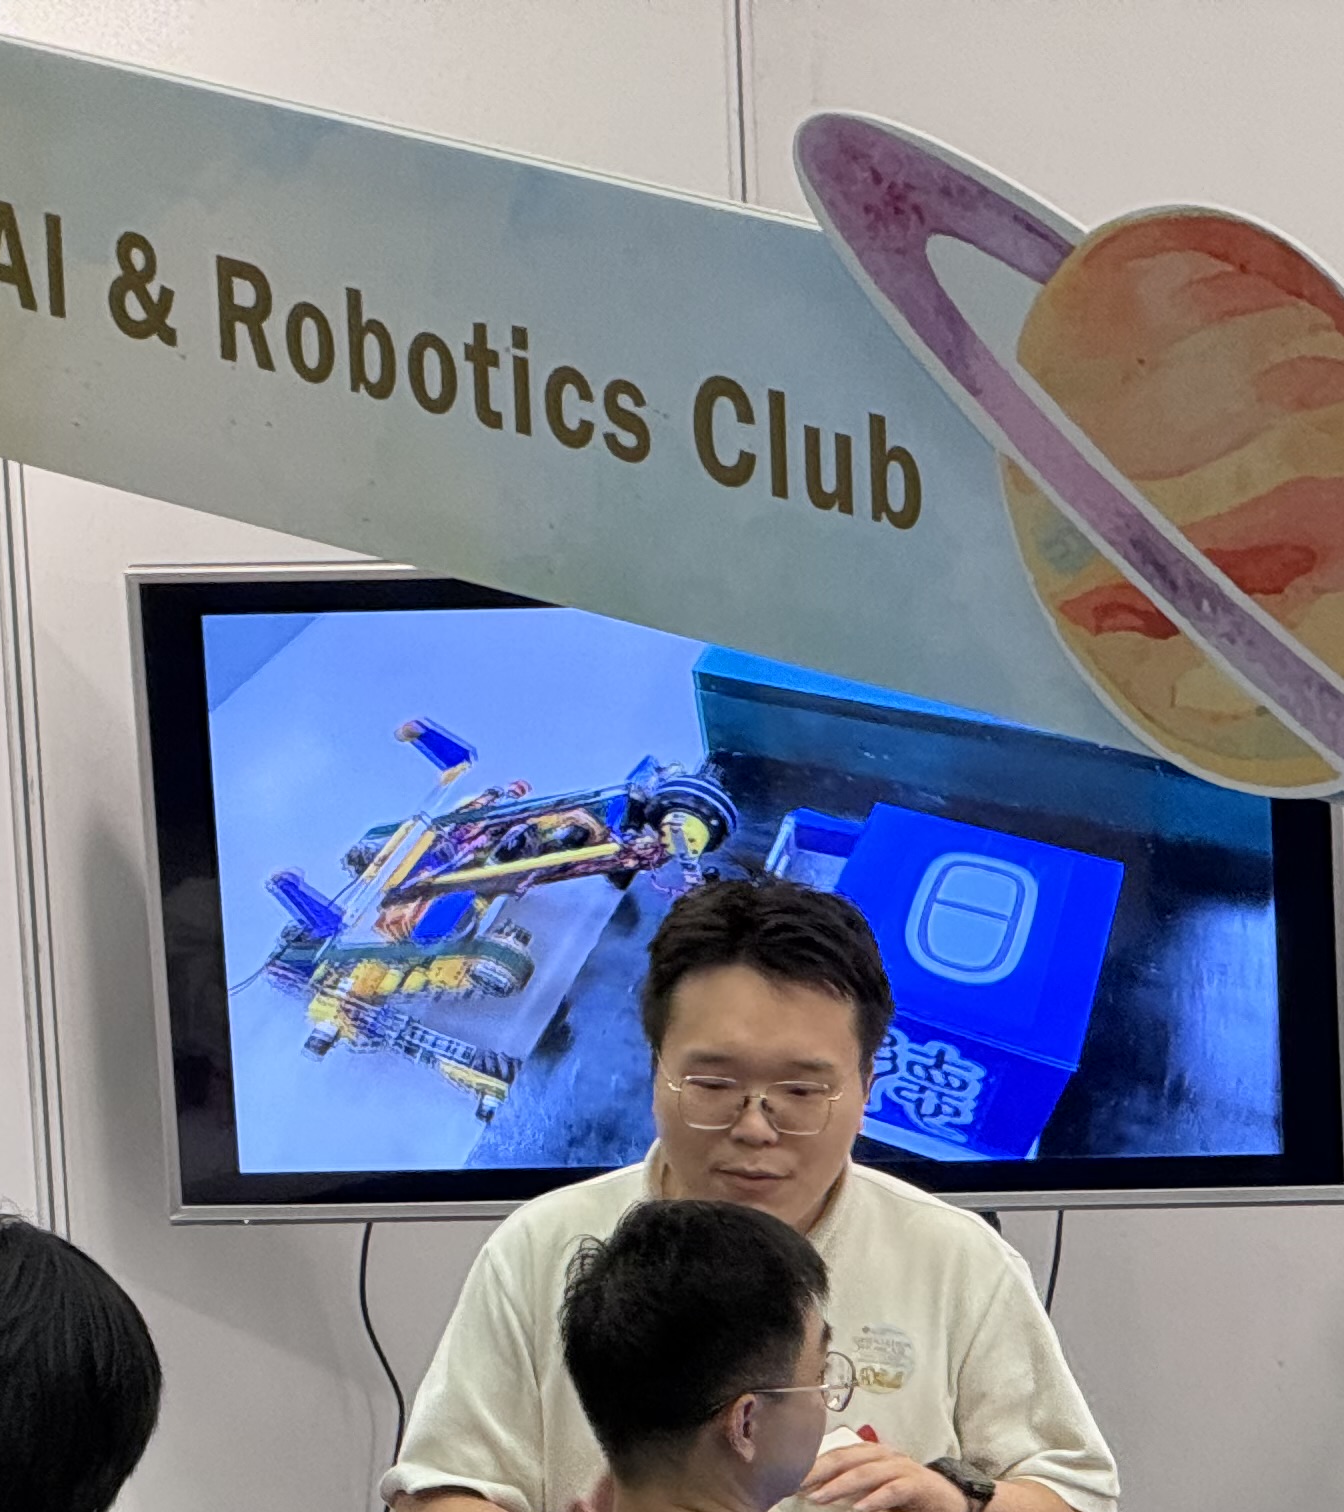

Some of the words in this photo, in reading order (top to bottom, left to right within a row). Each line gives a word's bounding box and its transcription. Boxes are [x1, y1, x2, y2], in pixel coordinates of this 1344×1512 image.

[108, 231, 177, 347] &
[215, 254, 651, 464] Robotics
[693, 375, 922, 531] Club
